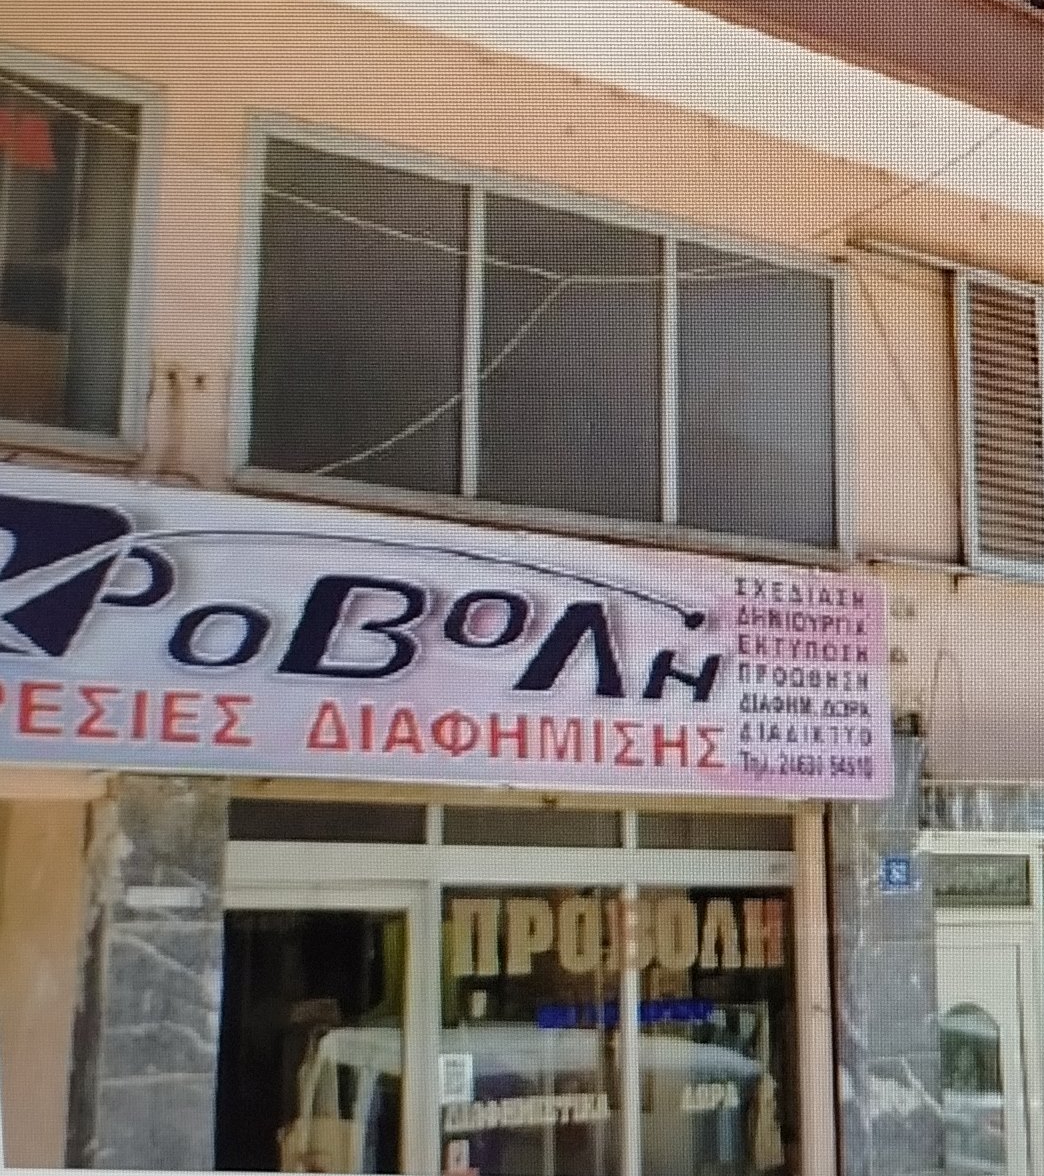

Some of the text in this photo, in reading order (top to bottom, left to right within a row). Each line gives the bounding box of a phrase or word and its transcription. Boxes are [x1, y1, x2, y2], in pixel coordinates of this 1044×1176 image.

[735, 578, 865, 609] ΣΧΕΔΙΑΣΗ
[737, 605, 867, 636] ΔΗΜΙΟΥΡΓΙΑ
[738, 633, 869, 664] ΕΚΤΥΠΩΣΗ
[738, 662, 869, 692] ΠΡΟΩΘΗΣΗ
[0, 681, 726, 769] ΕΣΙΕΣ ΔΙΑΦΗΜΙΣΗΣ
[739, 721, 873, 747] ΔΙΑΔΙΚΤΥΟ
